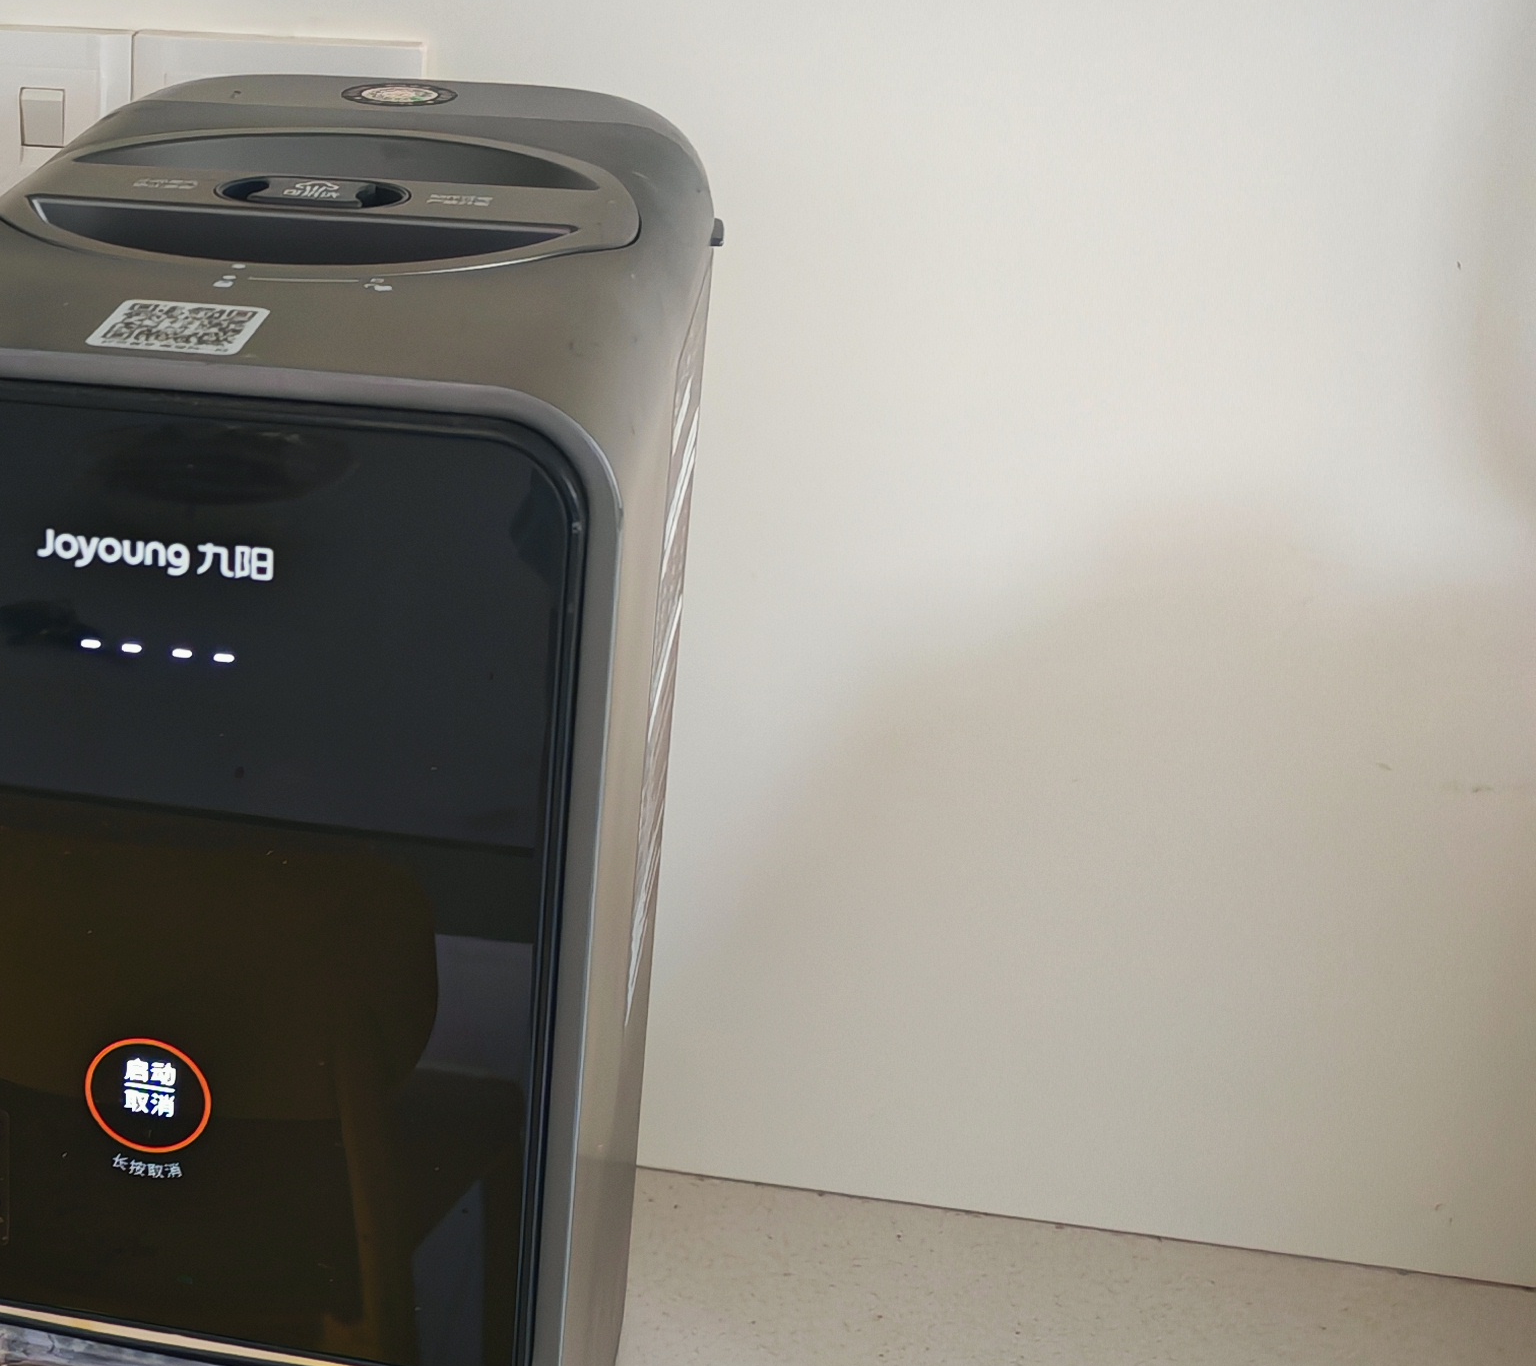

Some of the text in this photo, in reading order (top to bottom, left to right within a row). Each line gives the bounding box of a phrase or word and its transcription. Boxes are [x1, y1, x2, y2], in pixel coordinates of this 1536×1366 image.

[37, 528, 275, 582] Joyoung 九阳
[123, 1057, 177, 1087] 启动
[123, 1088, 176, 1118] 取消
[111, 1153, 184, 1179] 长按取消
